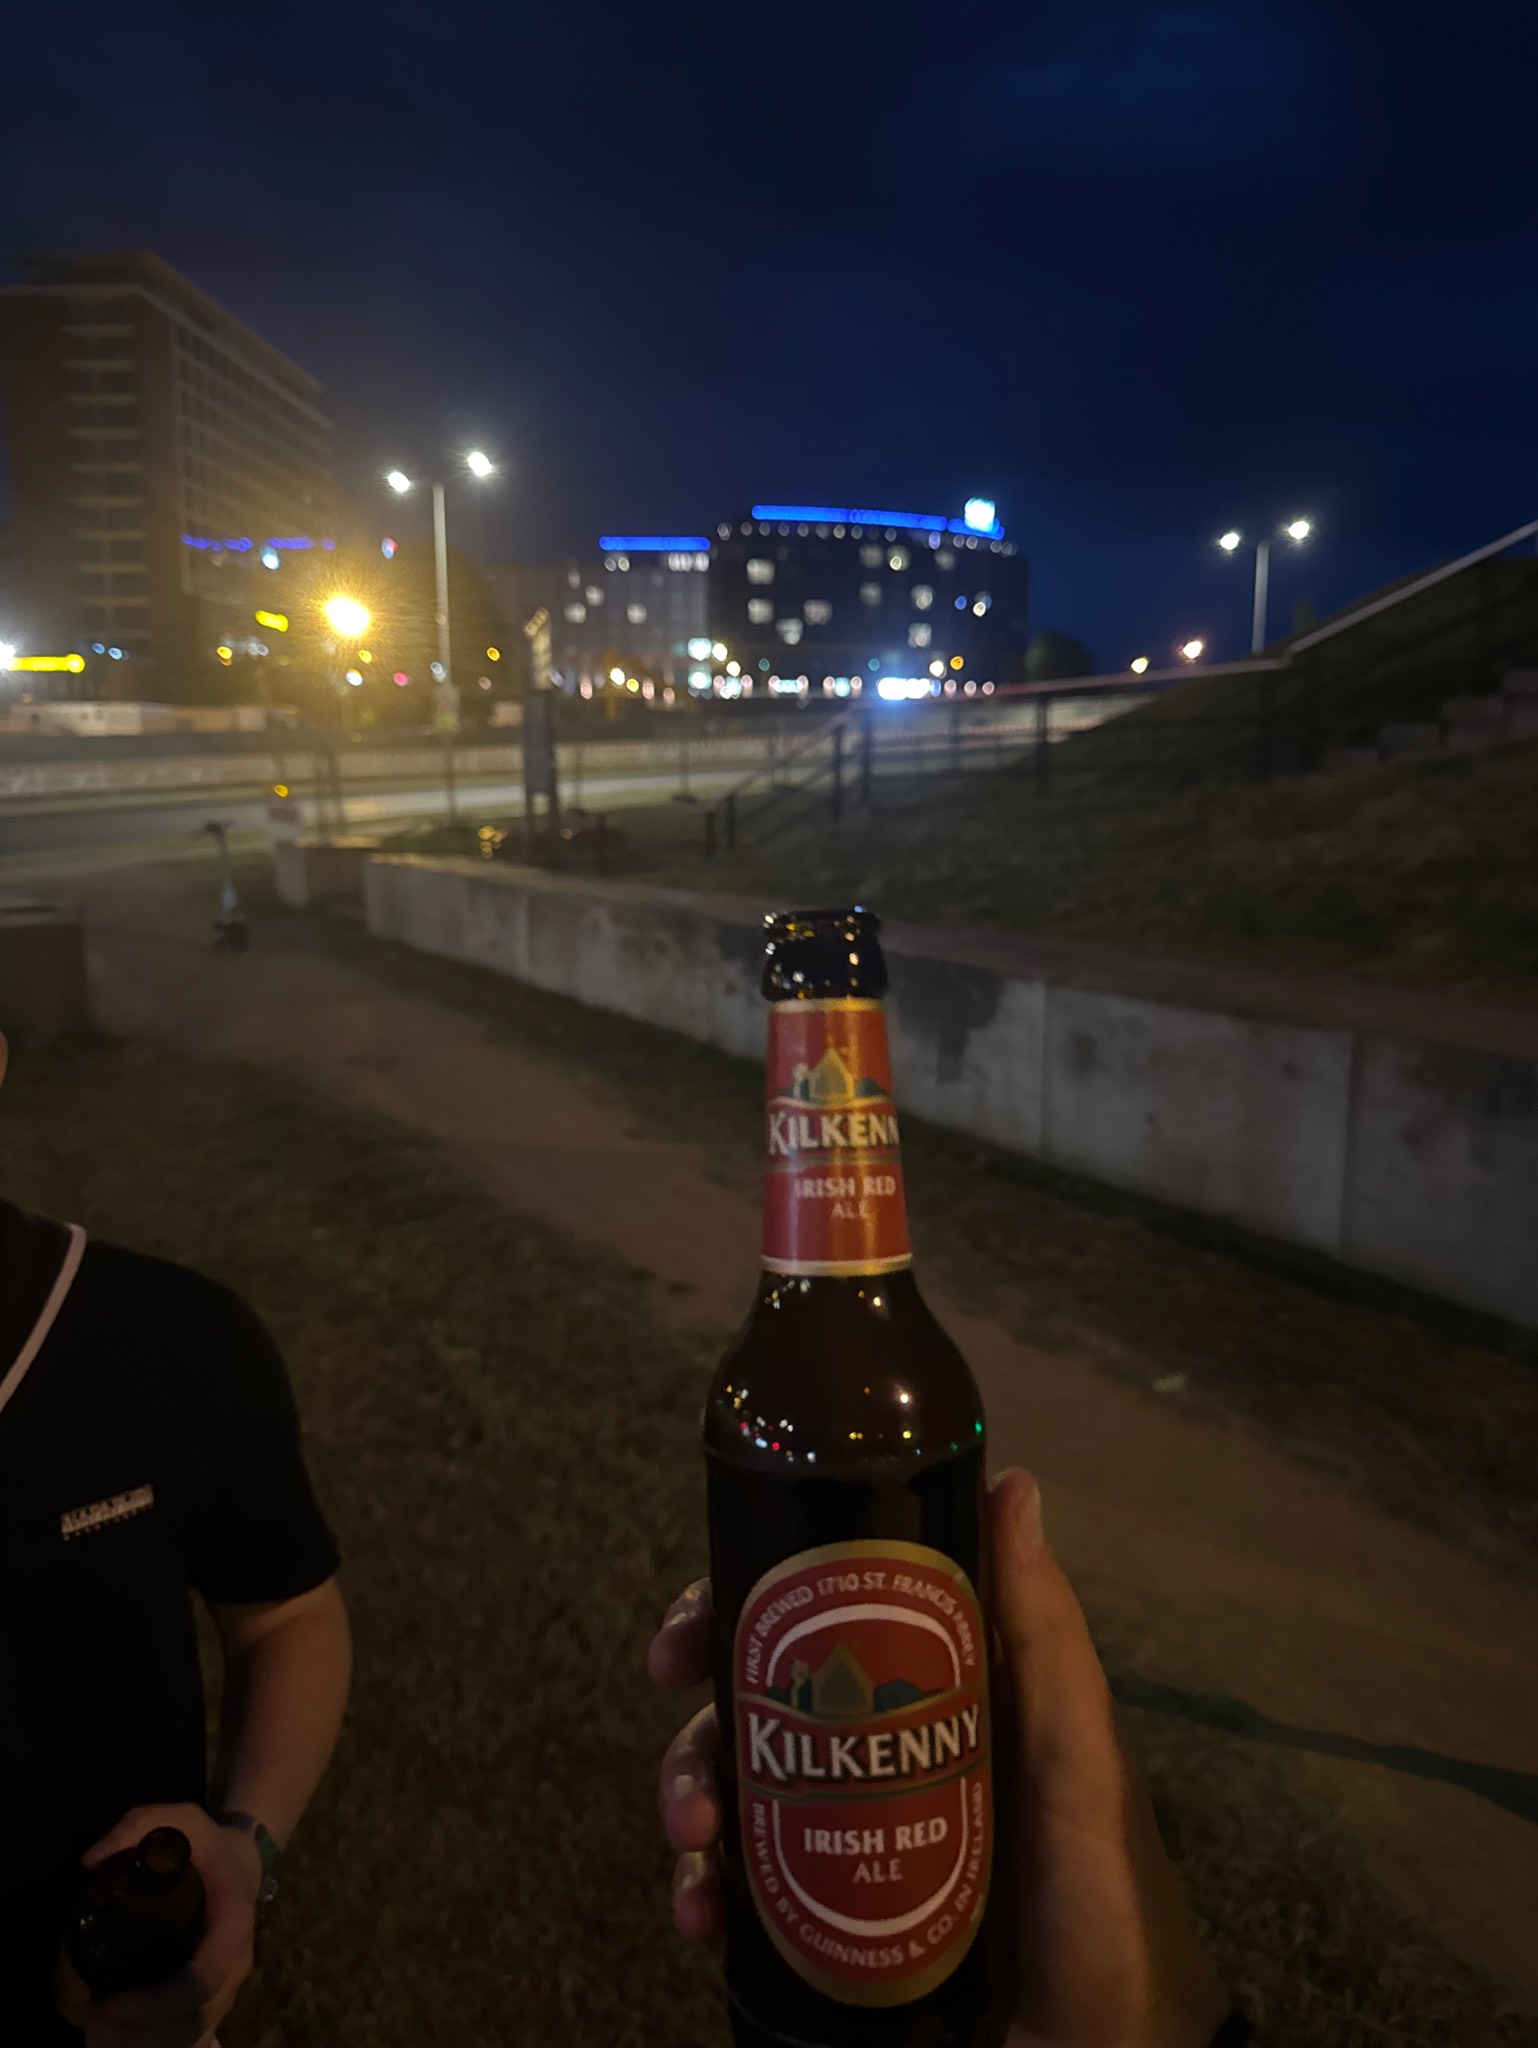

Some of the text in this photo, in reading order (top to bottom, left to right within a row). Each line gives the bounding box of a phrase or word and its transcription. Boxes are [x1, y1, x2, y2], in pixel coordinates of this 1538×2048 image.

[795, 1175, 897, 1198] IRISH RED
[831, 1199, 872, 1219] ALE
[747, 1703, 980, 1782] KILKENNY
[804, 1816, 949, 1856] IRISH RED
[852, 1857, 904, 1884] ALE
[775, 1896, 800, 1924] BY
[798, 1922, 906, 1969] GUINNESS
[953, 1883, 973, 1912] IN
